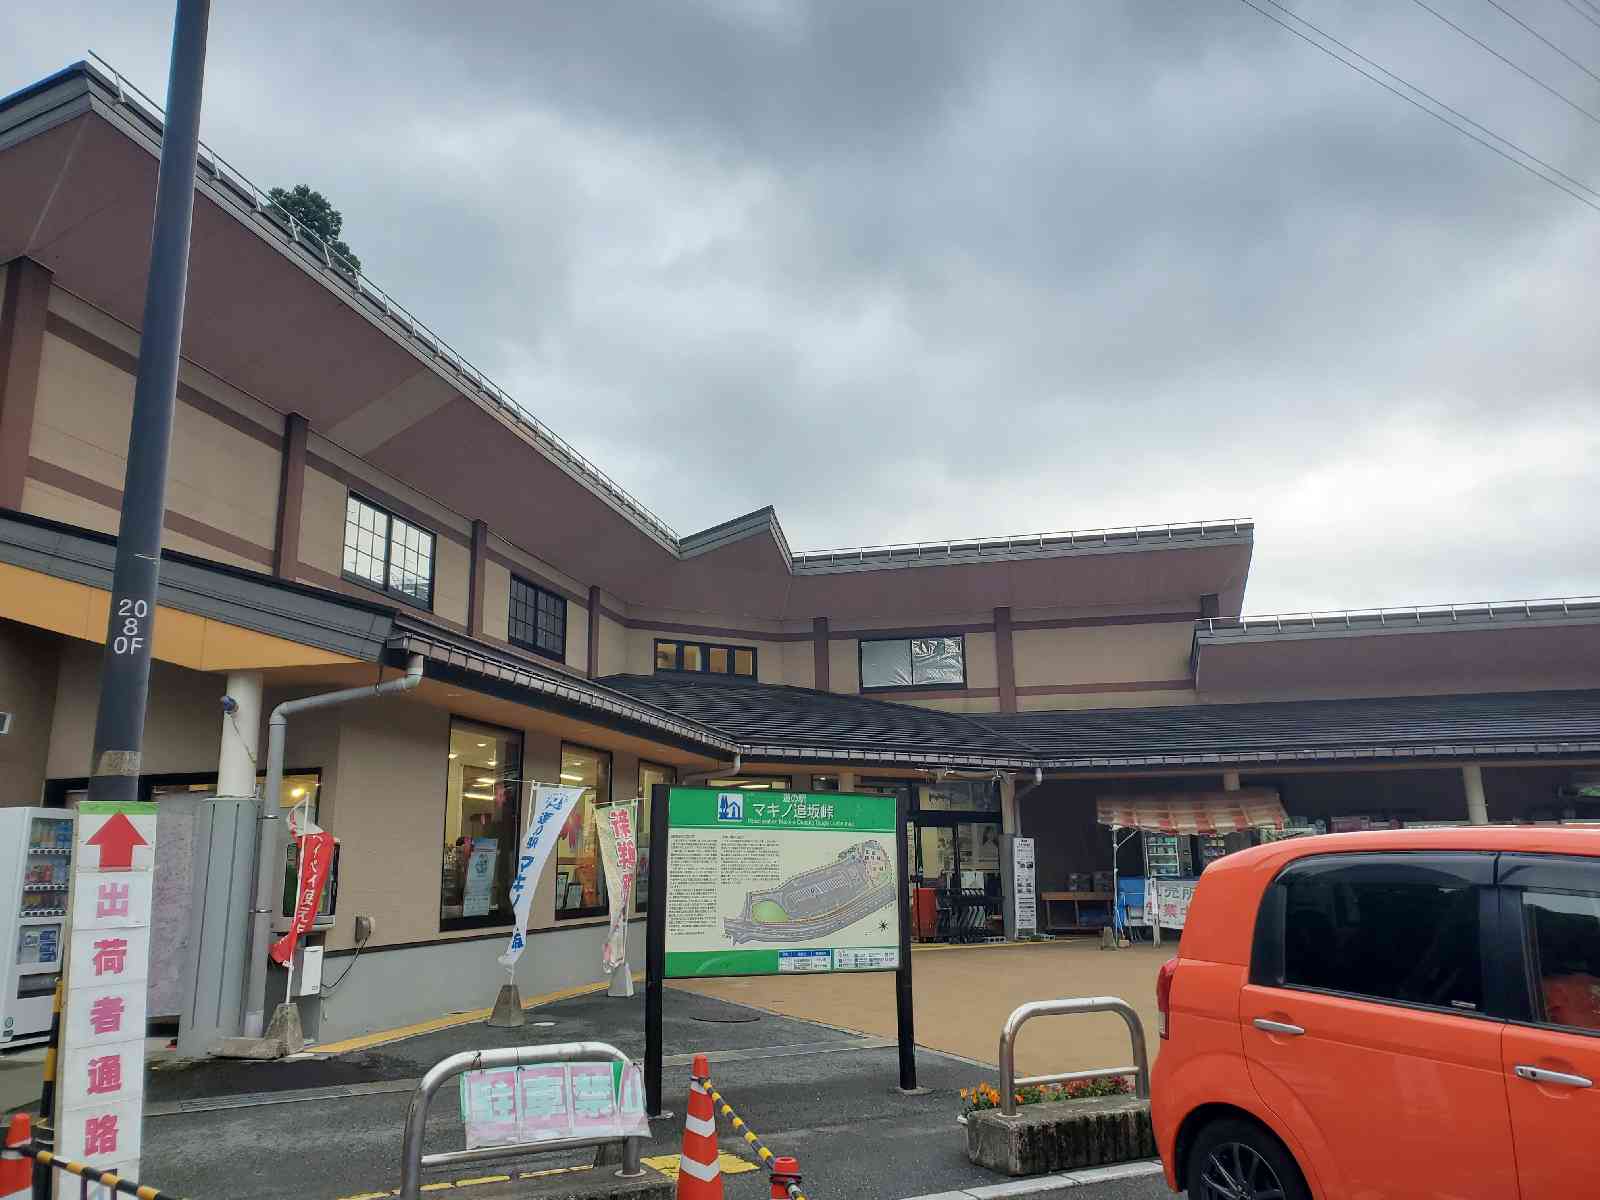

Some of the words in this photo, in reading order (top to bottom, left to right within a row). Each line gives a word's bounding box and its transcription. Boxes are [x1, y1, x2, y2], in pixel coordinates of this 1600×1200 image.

[118, 598, 148, 618] 20
[123, 617, 138, 636] 8
[752, 802, 834, 820] マキノ追坂峠
[84, 881, 131, 1157] 出荷者通路
